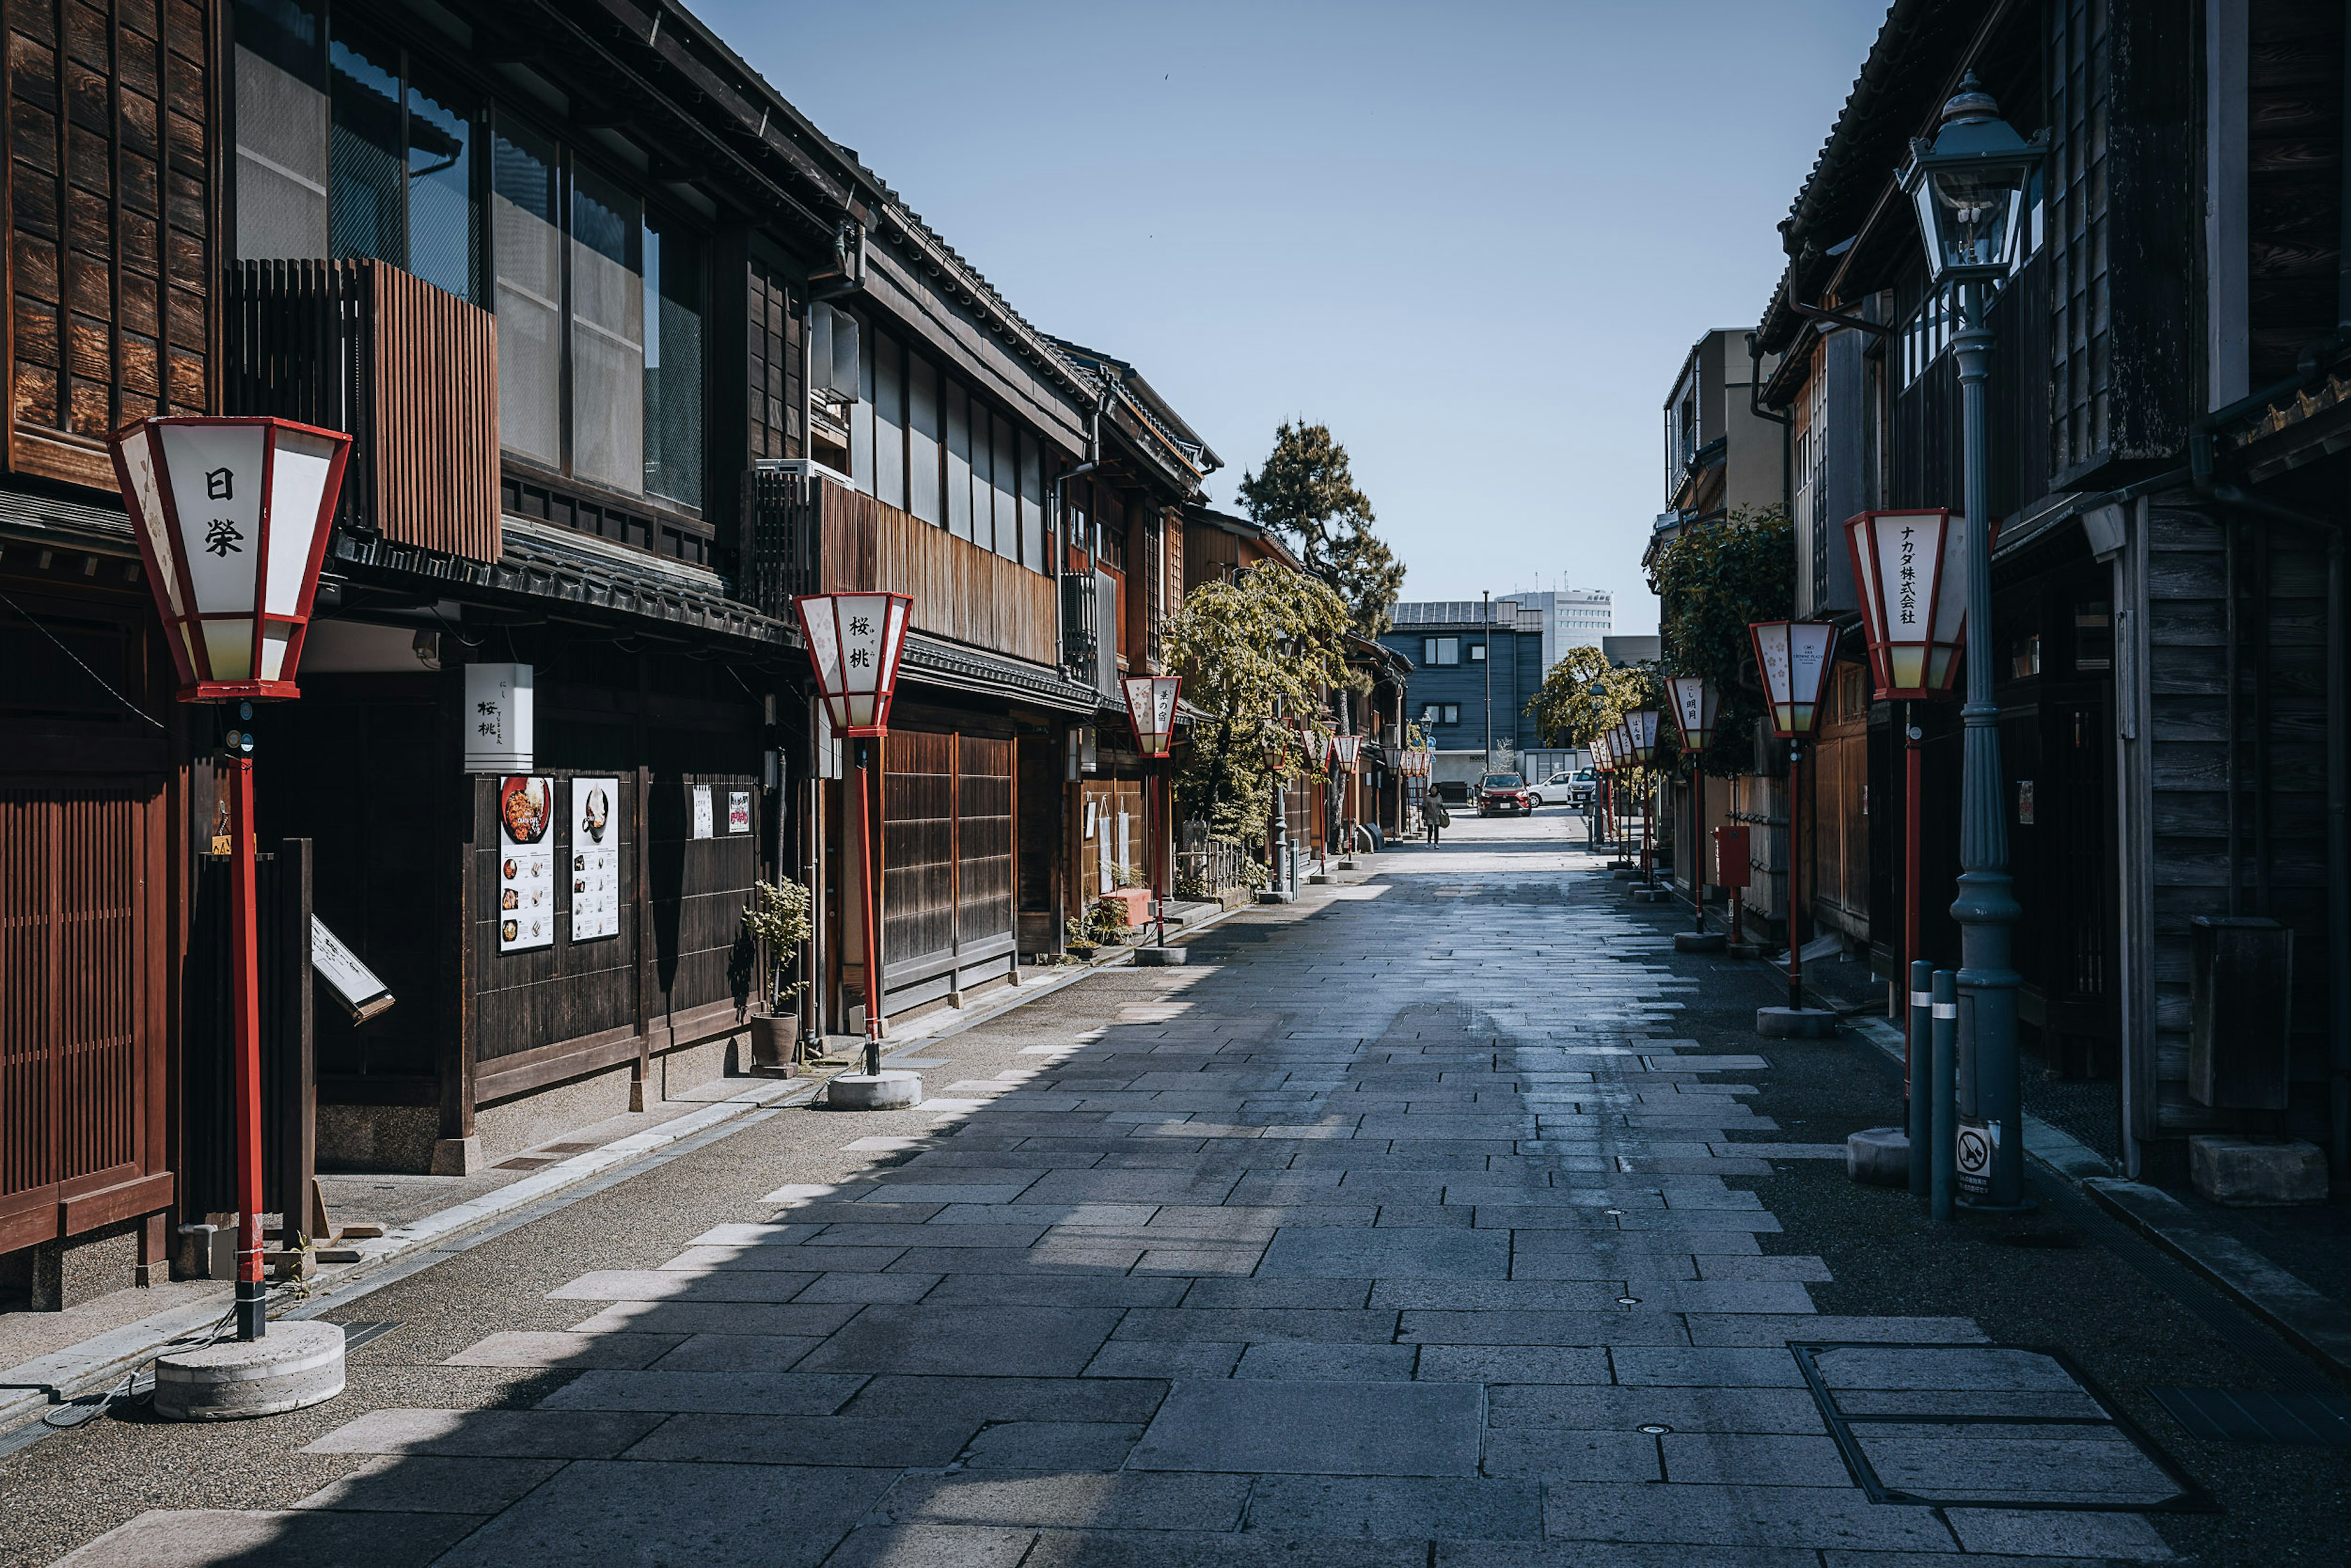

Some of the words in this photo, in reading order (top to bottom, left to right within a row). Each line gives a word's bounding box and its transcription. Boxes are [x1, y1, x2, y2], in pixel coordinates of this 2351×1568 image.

[205, 467, 244, 558] 日榮
[1900, 527, 1916, 624] ナカダ株式会社
[849, 616, 870, 669] 桜桃
[500, 681, 506, 699] にし
[1169, 683, 1174, 695] にし
[478, 702, 498, 737] 桜桃
